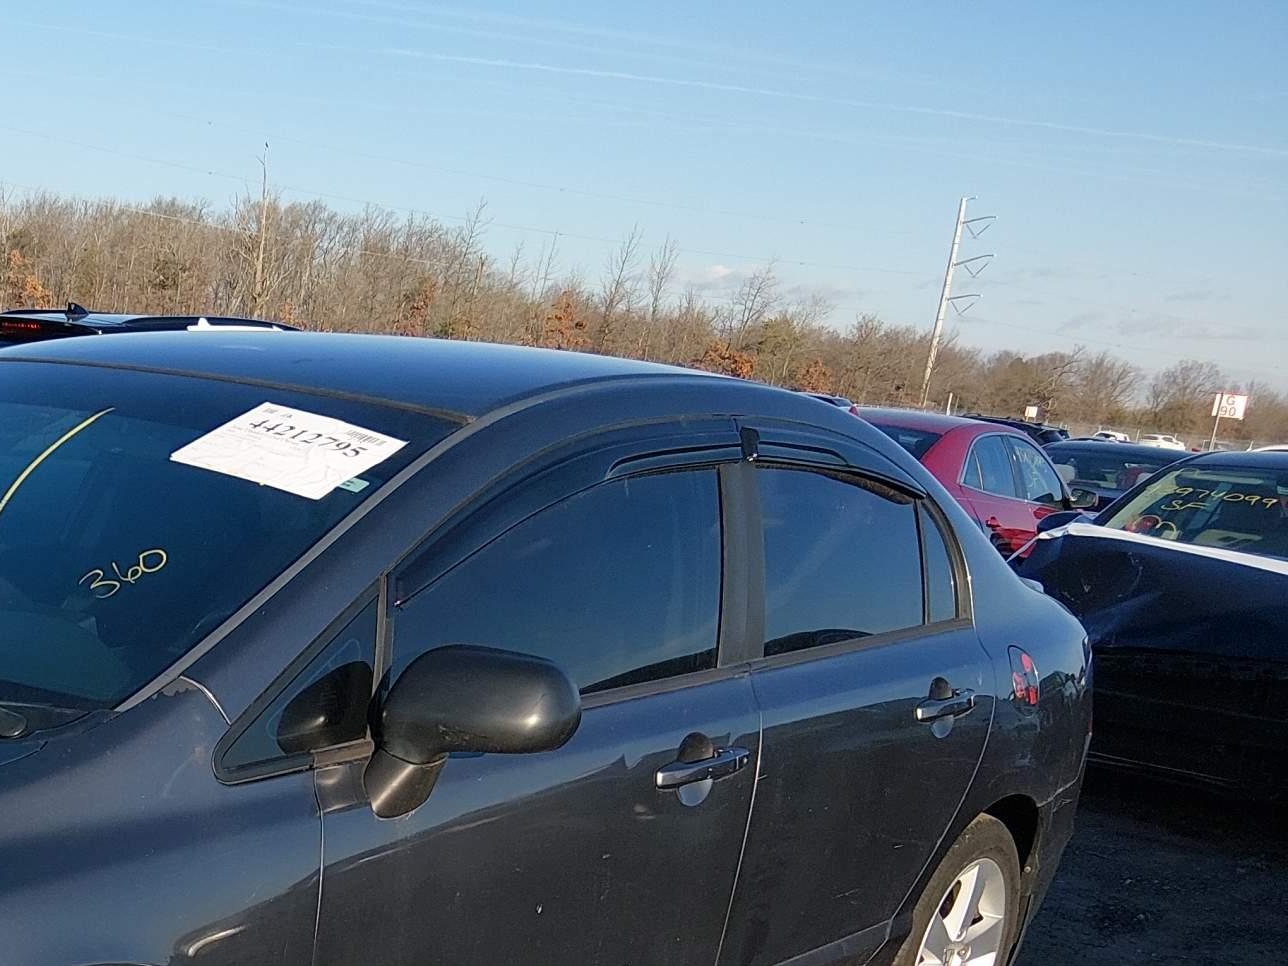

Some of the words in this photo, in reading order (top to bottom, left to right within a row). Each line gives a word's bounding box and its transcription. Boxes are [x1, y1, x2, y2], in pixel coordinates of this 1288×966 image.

[1226, 395, 1237, 405] G
[249, 420, 368, 457] 44212795
[78, 549, 167, 598] 360
